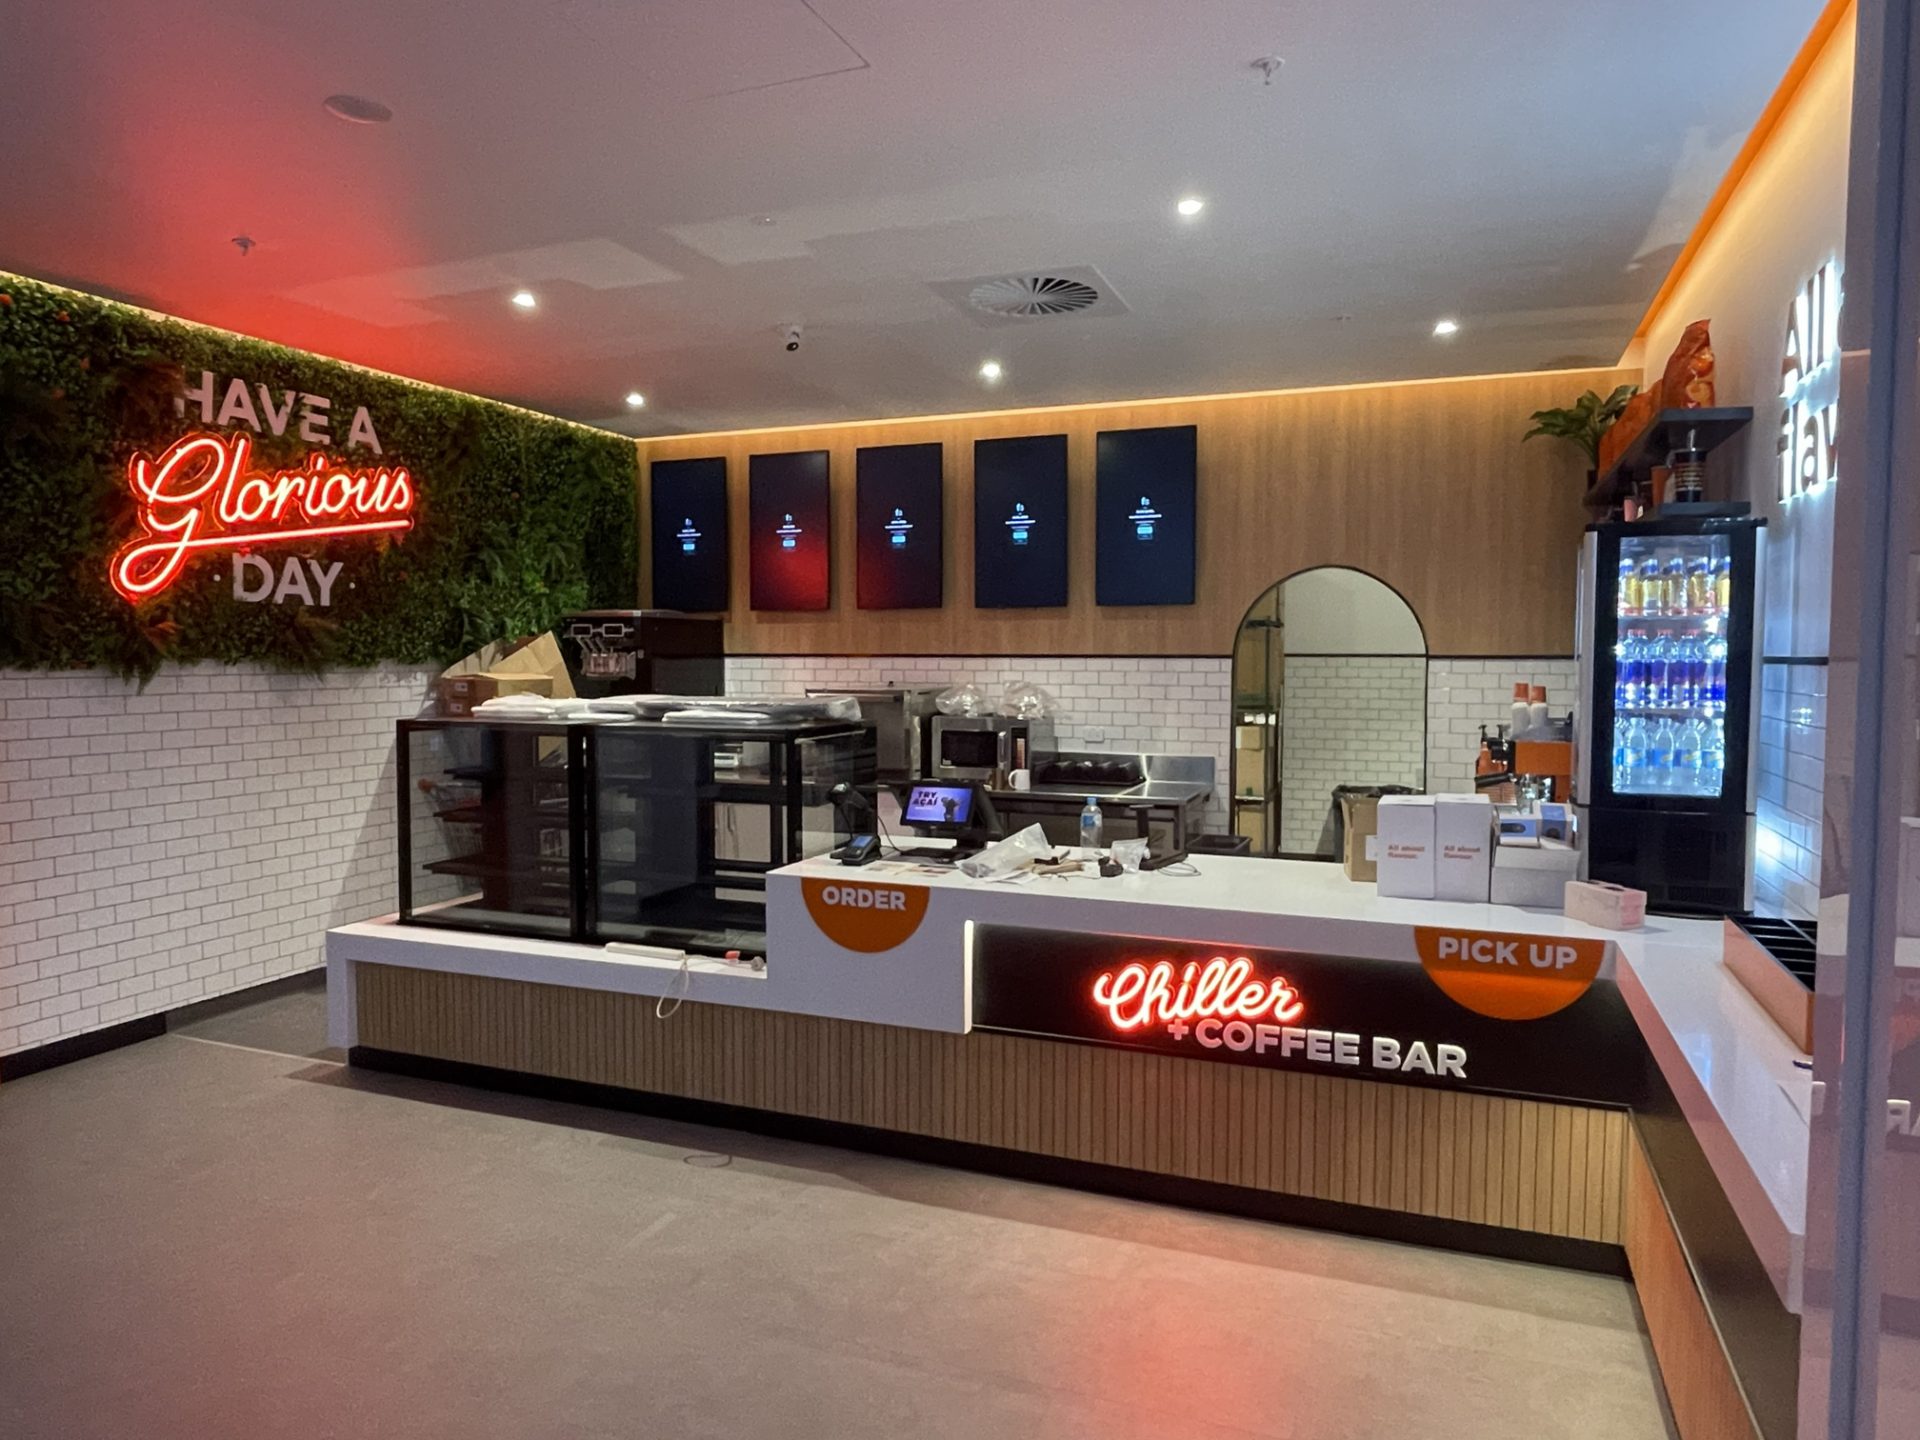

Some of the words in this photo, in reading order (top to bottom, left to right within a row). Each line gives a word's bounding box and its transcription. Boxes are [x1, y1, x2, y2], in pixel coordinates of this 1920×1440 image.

[173, 371, 330, 446] HAVE
[348, 406, 383, 455] A
[116, 436, 412, 594] Glorious
[233, 553, 344, 607] DAY
[918, 791, 937, 799] TRY
[821, 885, 906, 911] ORDER
[1437, 936, 1519, 966] PICK
[1528, 942, 1578, 969] UP
[1094, 956, 1303, 1030] Chiller
[1372, 1036, 1467, 1079] BAR
